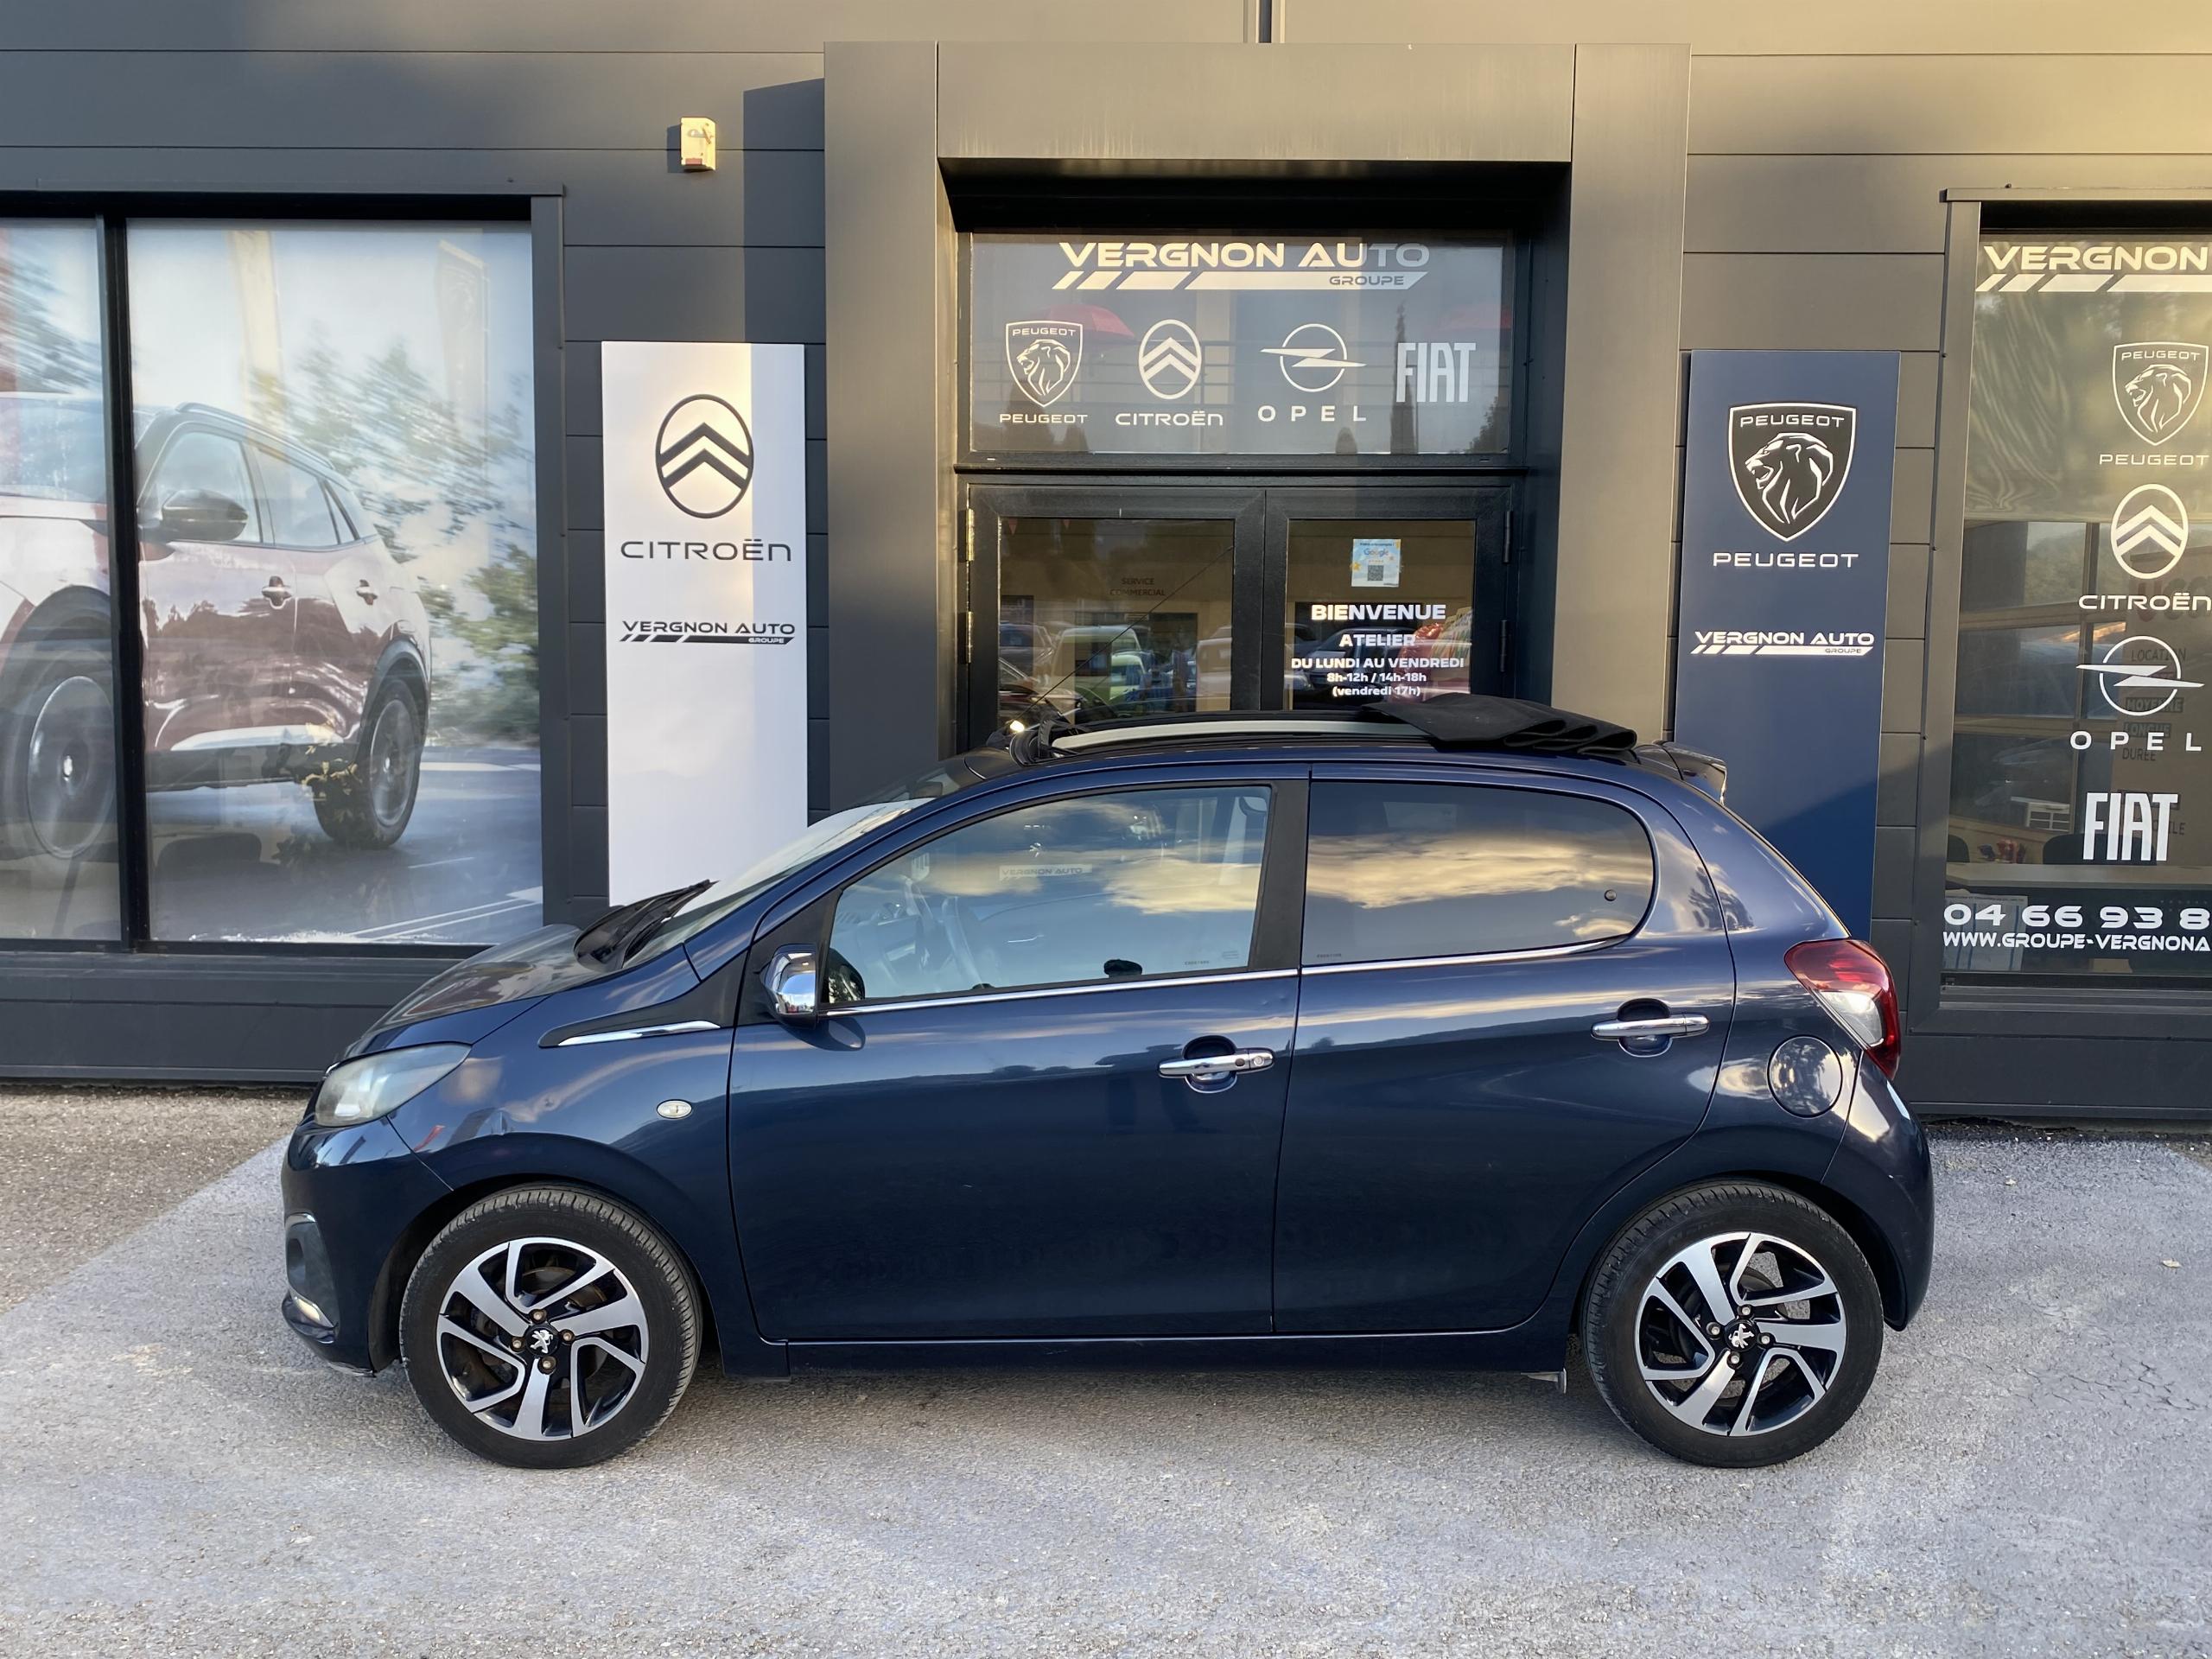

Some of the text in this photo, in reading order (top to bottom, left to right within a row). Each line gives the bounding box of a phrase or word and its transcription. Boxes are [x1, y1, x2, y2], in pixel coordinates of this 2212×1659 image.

[1058, 242, 1430, 268] VERGNON AUTO
[1983, 245, 2209, 271] VERGNON
[1328, 275, 1405, 286] GROUPE
[1012, 327, 1077, 337] PEUGEOT
[2120, 350, 2201, 362] PEUGEOT
[1395, 342, 1477, 404] FIAT
[999, 413, 1088, 424] PEUGEOT
[1257, 404, 1367, 423] OPEL
[1739, 414, 1845, 429] PEUGEOT
[2098, 453, 2209, 466] PEUGEOT
[1712, 551, 1859, 568] PEUGEOT
[1311, 604, 1446, 620] BIENVENUE
[622, 620, 796, 635] VERGNON AUTO
[747, 636, 785, 645] GROUPE
[1338, 633, 1417, 647] ATELIER
[1694, 631, 1875, 645] VERGNON AUTO
[2131, 648, 2186, 662] LOCATIN
[1291, 658, 1465, 669] DU LUNDI AU VENDREDI
[1326, 672, 1427, 683] 8h-12h / 14h-18h
[1332, 685, 1421, 697] (vendredi 17h)
[2069, 730, 2202, 752] OPEL
[2082, 791, 2179, 861] FIAT
[1943, 903, 2210, 931] 04 66 93 8
[1942, 931, 2211, 952] WWW.GROUPE-VERGNONA
